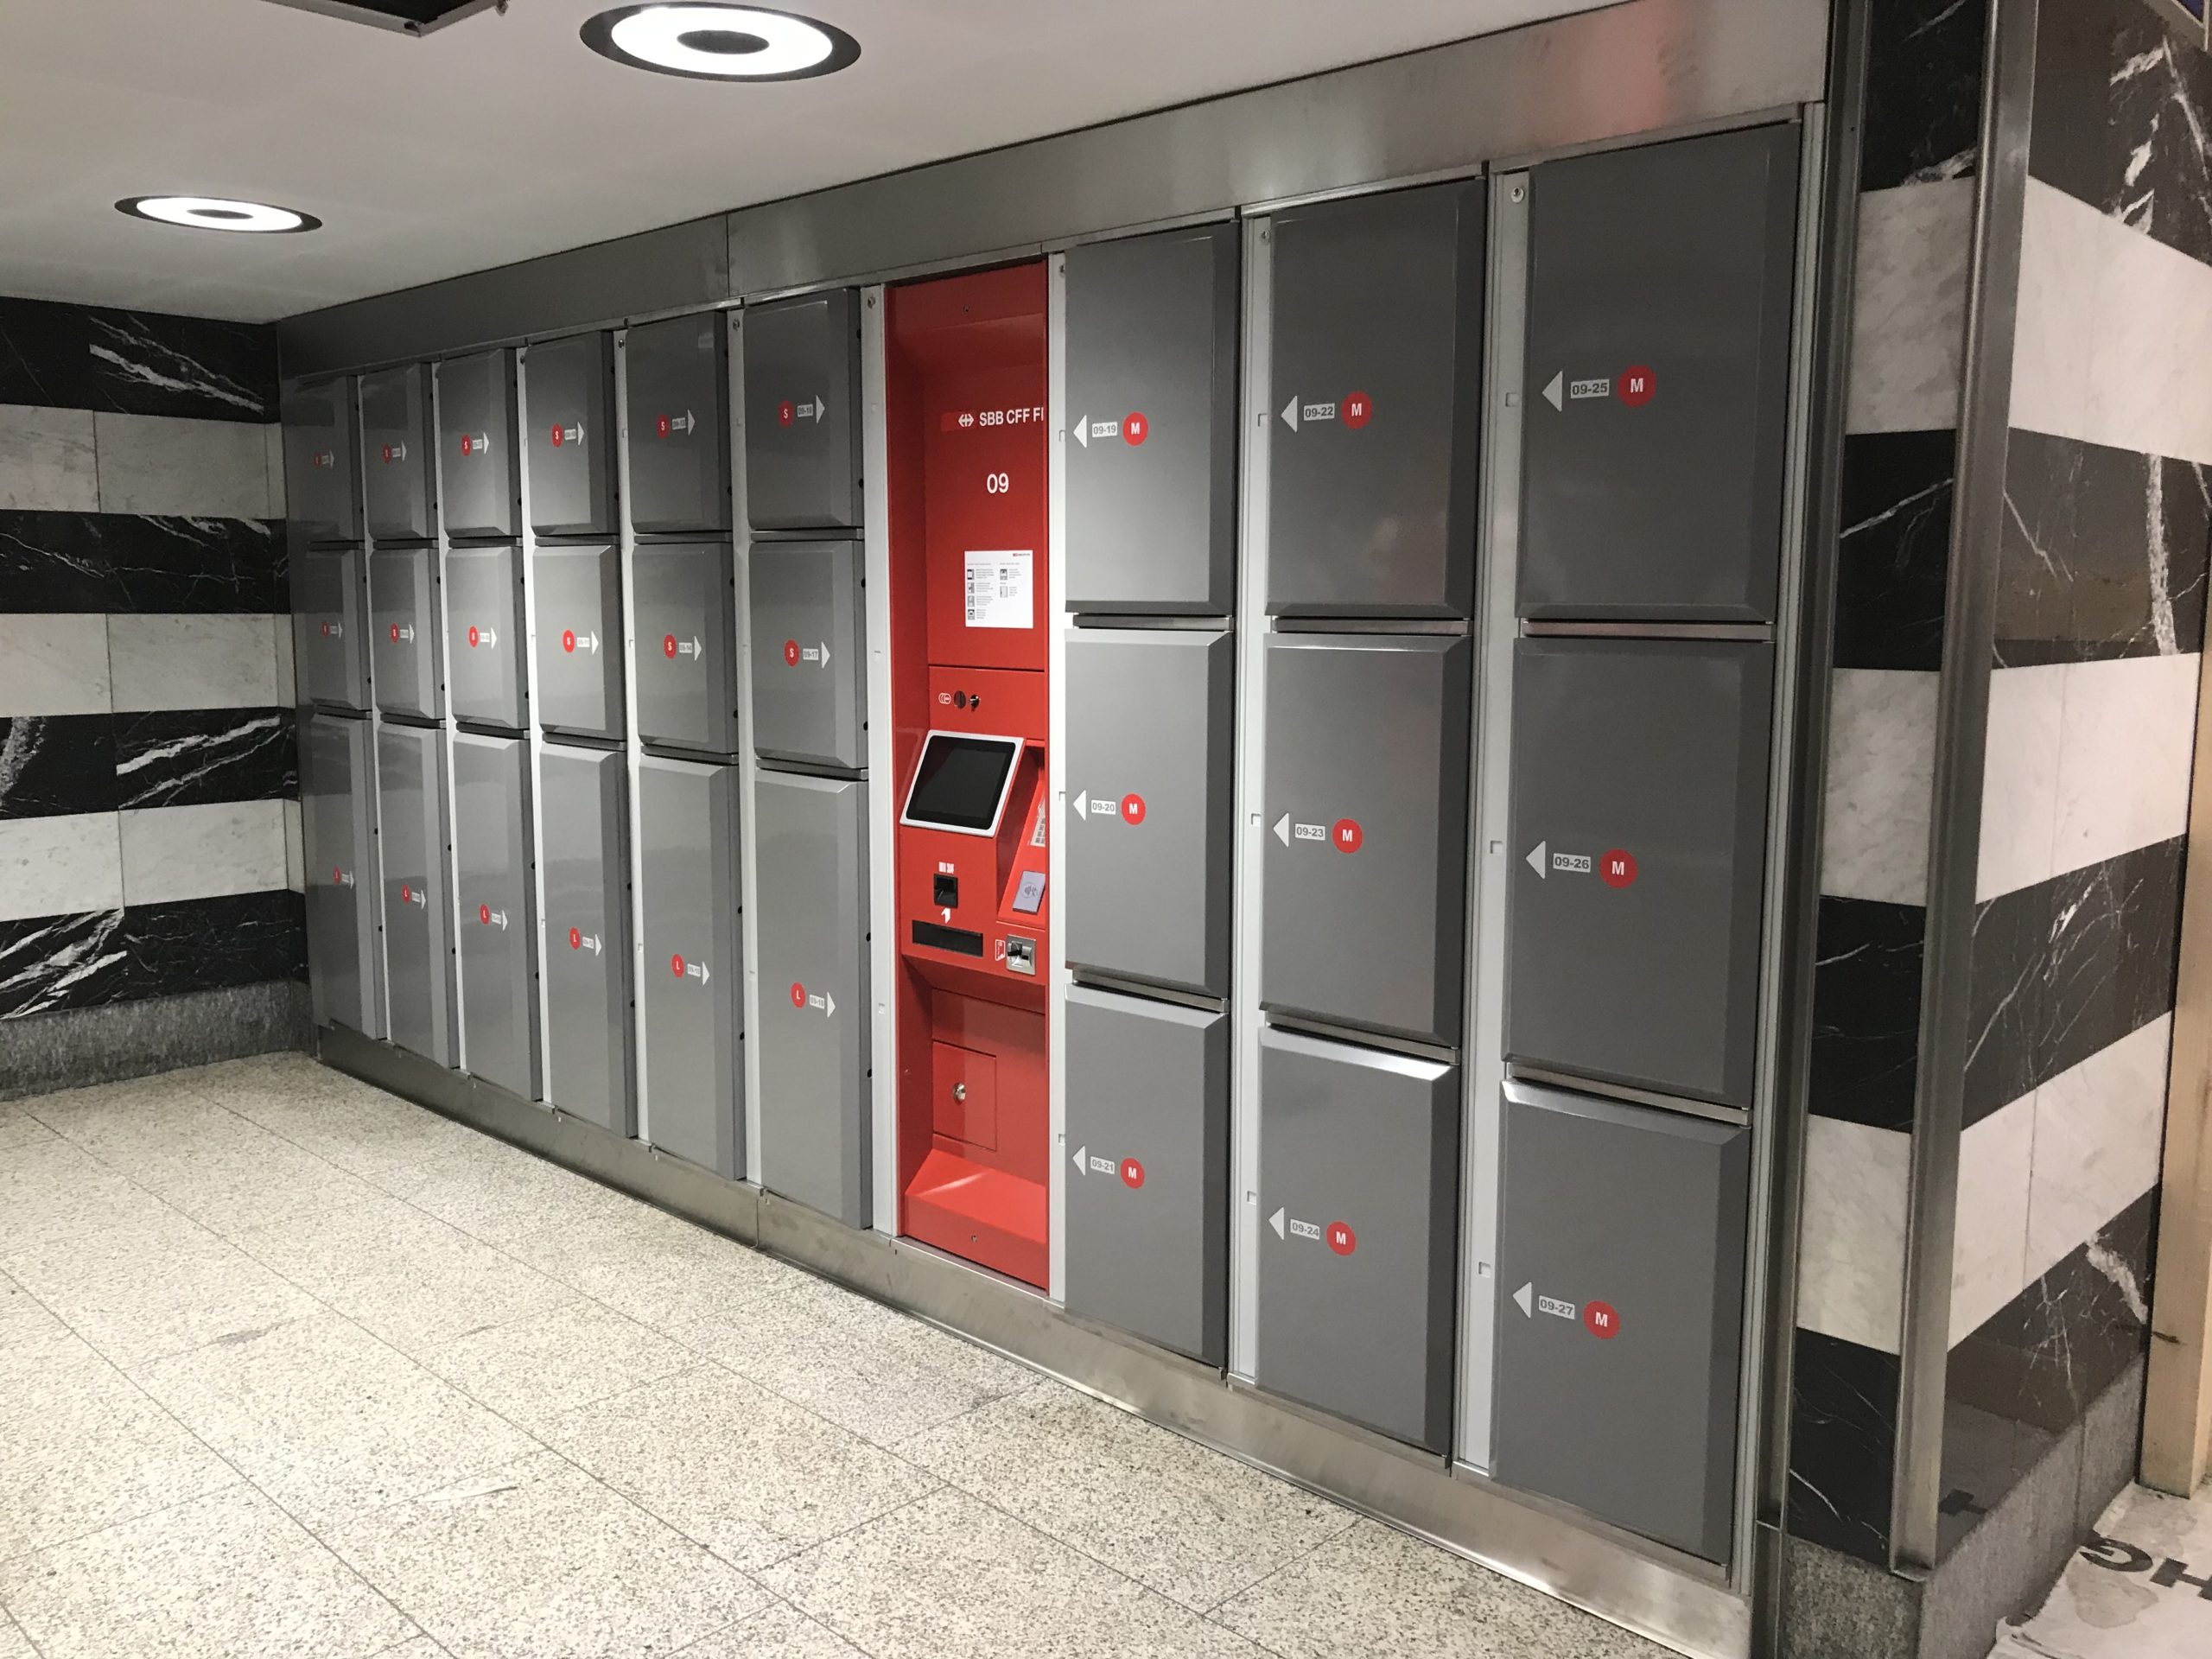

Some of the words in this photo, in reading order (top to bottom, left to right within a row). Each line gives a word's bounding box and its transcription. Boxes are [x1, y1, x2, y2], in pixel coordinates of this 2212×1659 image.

[1572, 382, 1608, 396] 09-25
[1630, 378, 1643, 393] M
[979, 410, 1004, 426] SBB
[1007, 408, 1030, 424] CFF
[1305, 405, 1334, 419] 09-22
[1351, 403, 1363, 416] M
[1093, 425, 1116, 435] 09-19
[1130, 422, 1141, 435] M
[987, 473, 1009, 493] 09
[804, 650, 818, 659] 09-17
[1092, 802, 1115, 812] 09-20
[1128, 803, 1138, 815] M
[1296, 826, 1324, 838] 09-23
[1342, 829, 1353, 842] M
[1554, 855, 1590, 870] 09-26
[1611, 861, 1624, 875] M
[1091, 1159, 1114, 1173] 09-21
[1128, 1167, 1137, 1179] M
[1292, 1222, 1319, 1237] 09-24
[1336, 1231, 1346, 1245] M
[1540, 1298, 1573, 1317] 09-27
[1594, 1312, 1608, 1327] M
